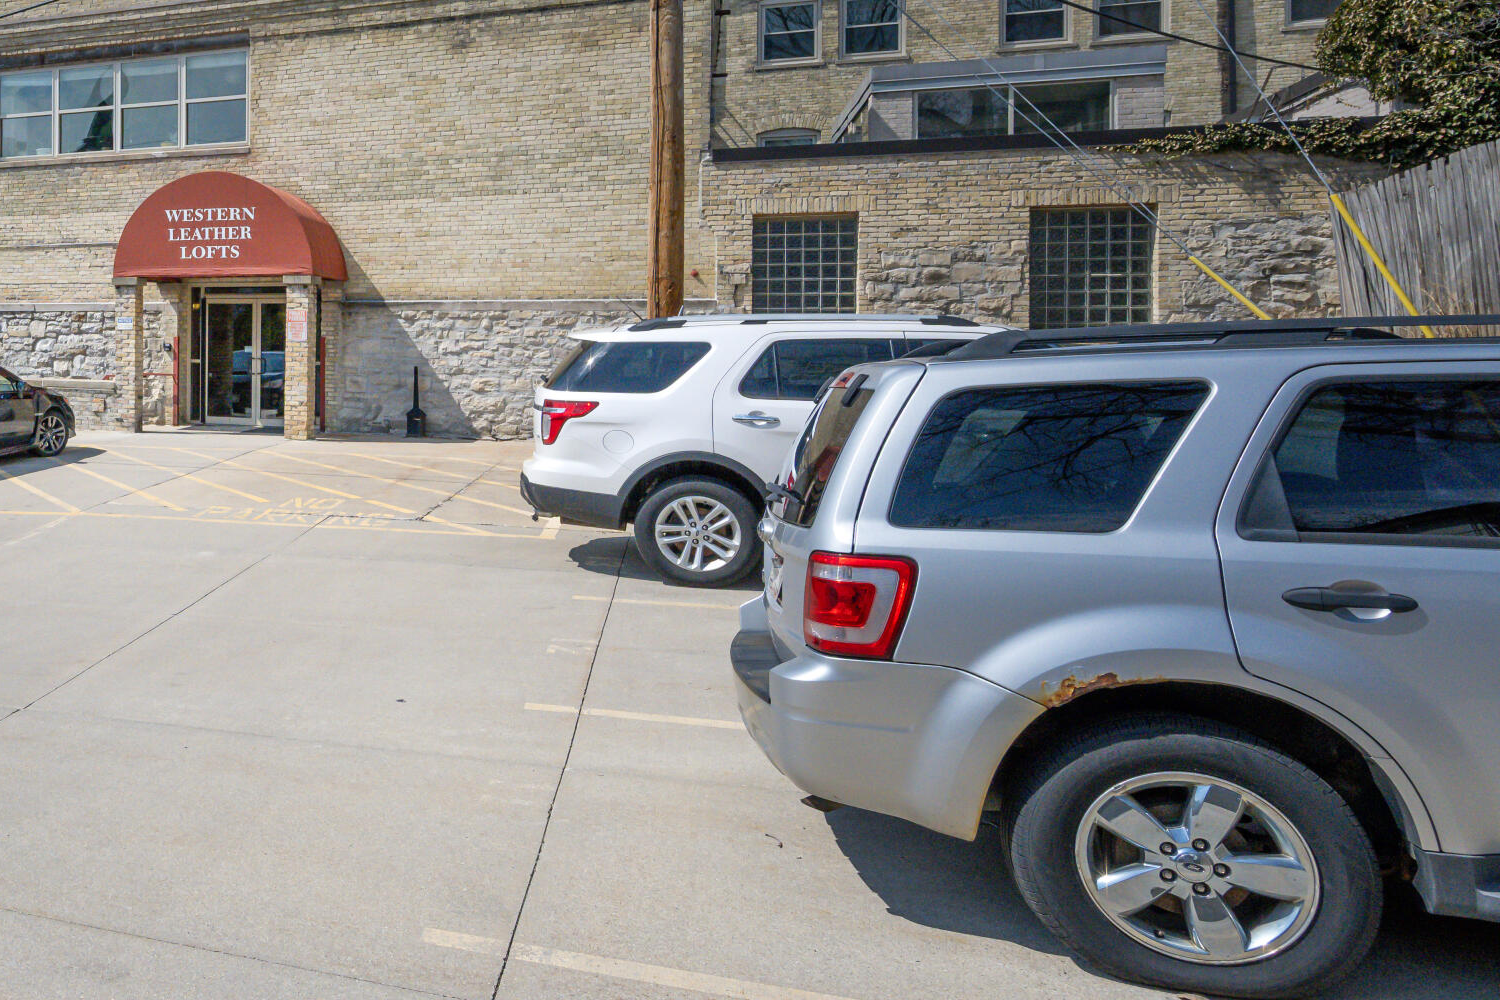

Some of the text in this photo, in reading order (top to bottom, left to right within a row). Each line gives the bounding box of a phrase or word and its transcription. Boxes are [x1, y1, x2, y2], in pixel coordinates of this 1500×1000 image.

[164, 206, 257, 222] WESTERN
[168, 226, 252, 241] LEATHER
[180, 245, 240, 259] LOFTS
[278, 497, 347, 510] NO
[195, 506, 396, 526] PARKING
